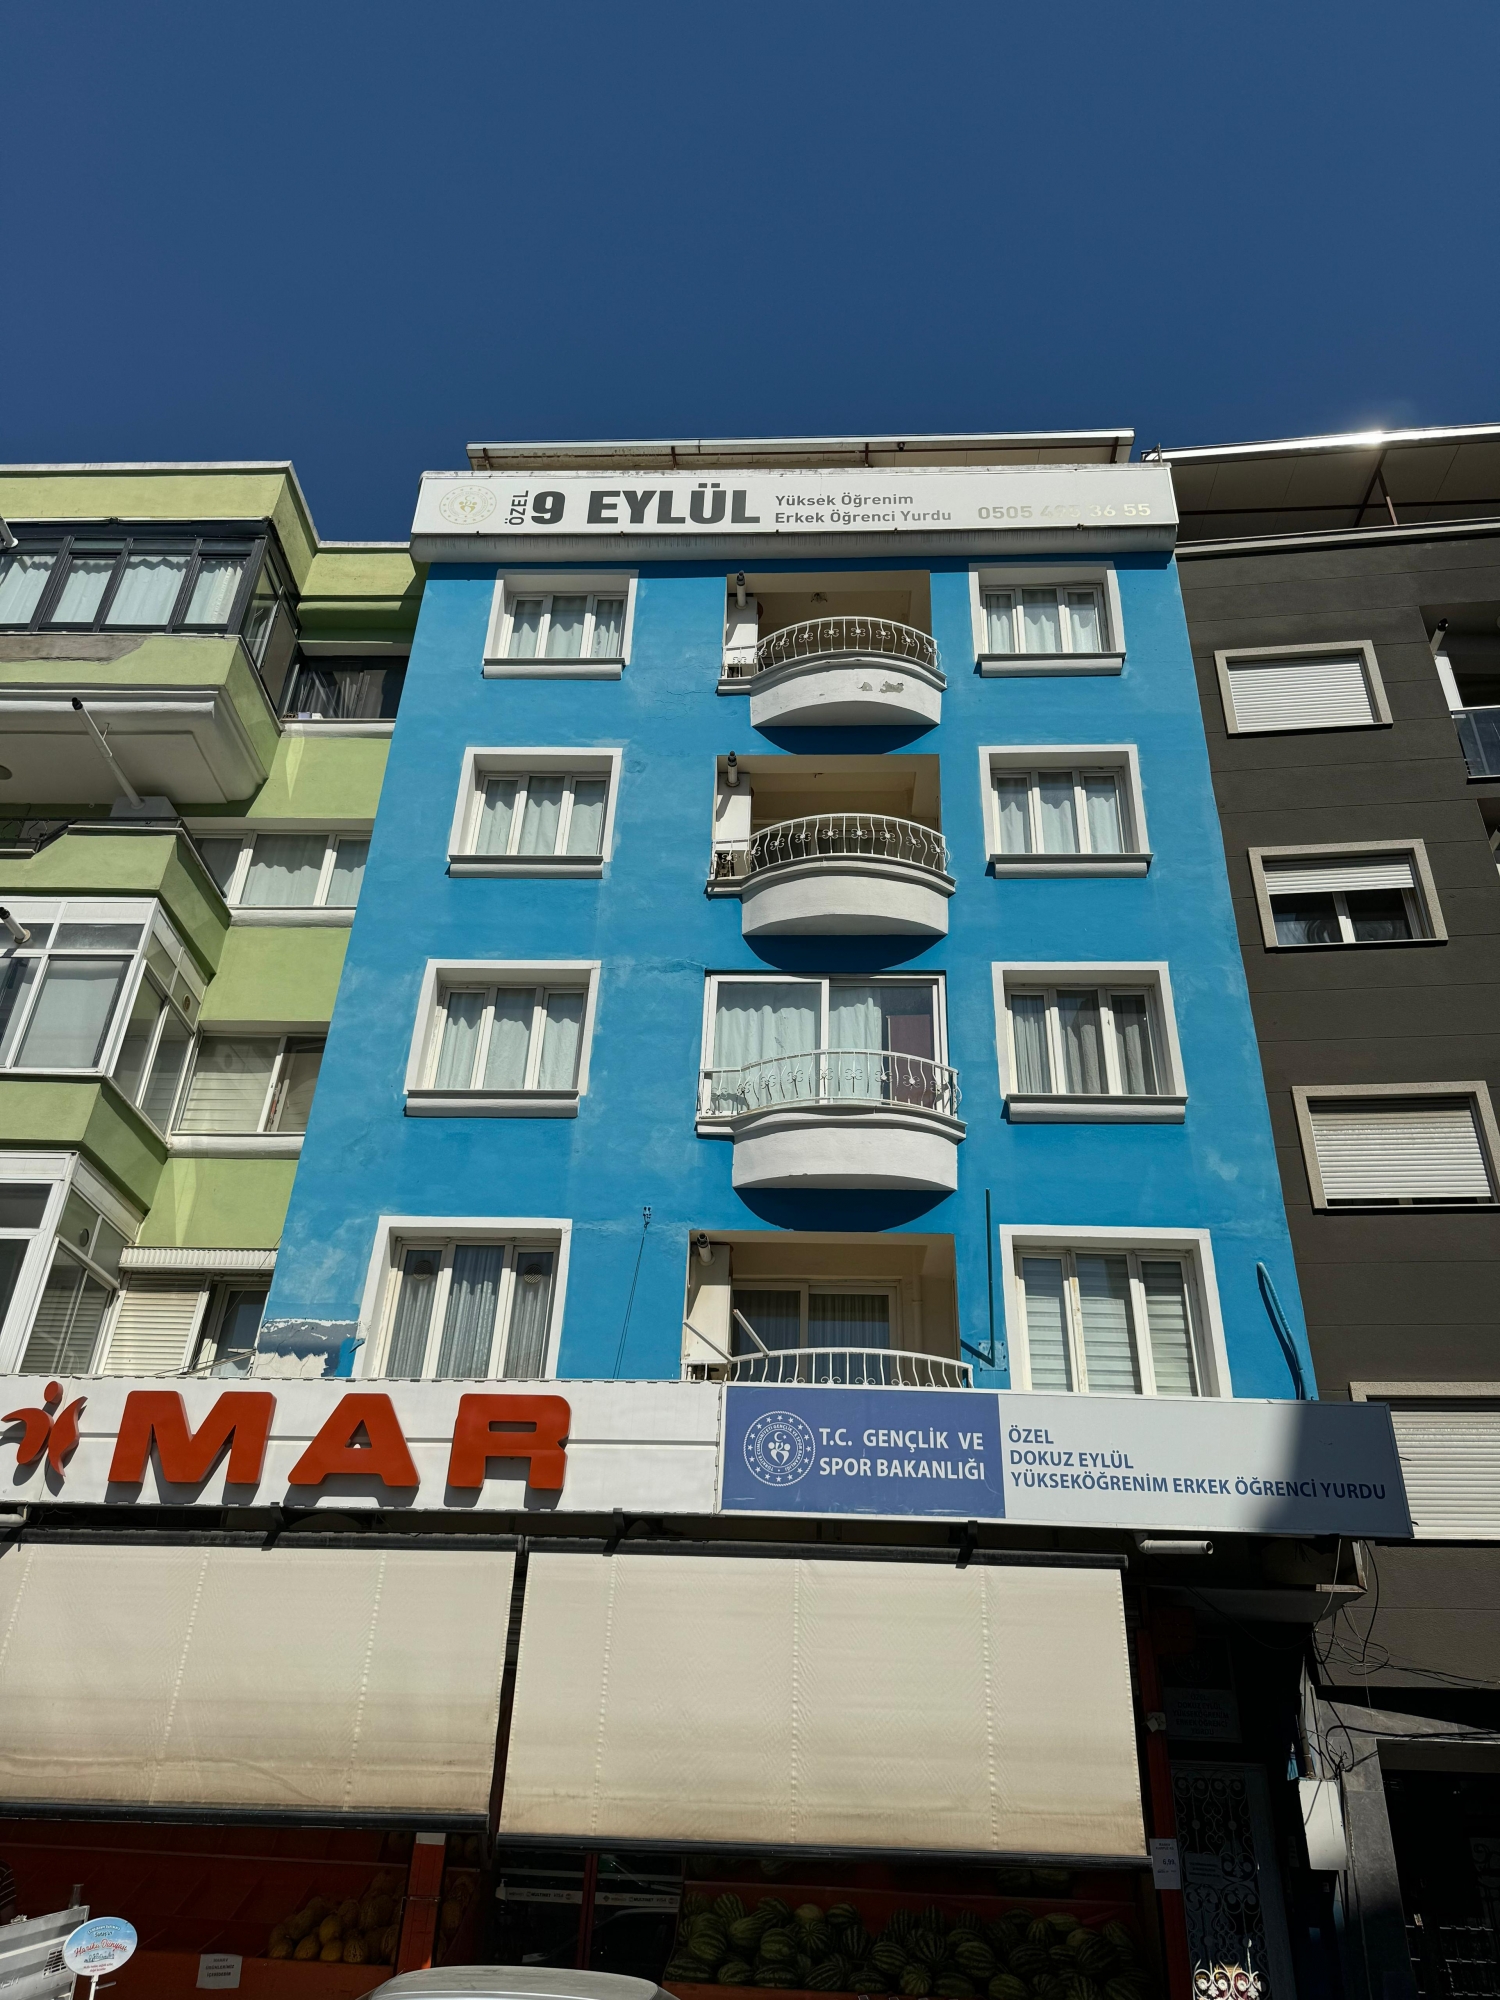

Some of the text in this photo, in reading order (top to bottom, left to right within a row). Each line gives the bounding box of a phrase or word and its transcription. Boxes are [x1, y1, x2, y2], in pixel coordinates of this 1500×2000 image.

[504, 490, 529, 526] ÖZEL
[531, 491, 566, 525] 9
[586, 483, 761, 525] EYLÜL
[775, 492, 914, 508] Yüksek Öğrenim
[775, 509, 952, 526] Erkek Öğrenci Yurdu
[977, 505, 1033, 520] 0505
[1088, 504, 1117, 518] 36
[1123, 503, 1152, 517] 55
[108, 1390, 573, 1490] MAR
[819, 1427, 984, 1453] T.C. GENÇLİK VE
[1008, 1425, 1055, 1445] ÖZEL
[819, 1456, 986, 1480] SPOR BAKANLIĞI
[1010, 1450, 1134, 1469] DOKUZ EYLÜL
[1011, 1471, 1387, 1501] YÜKSEKÖĞRENİM ERKEK ÖĞRENCİ YURDU
[1177, 1701, 1201, 1709] DOKUZ
